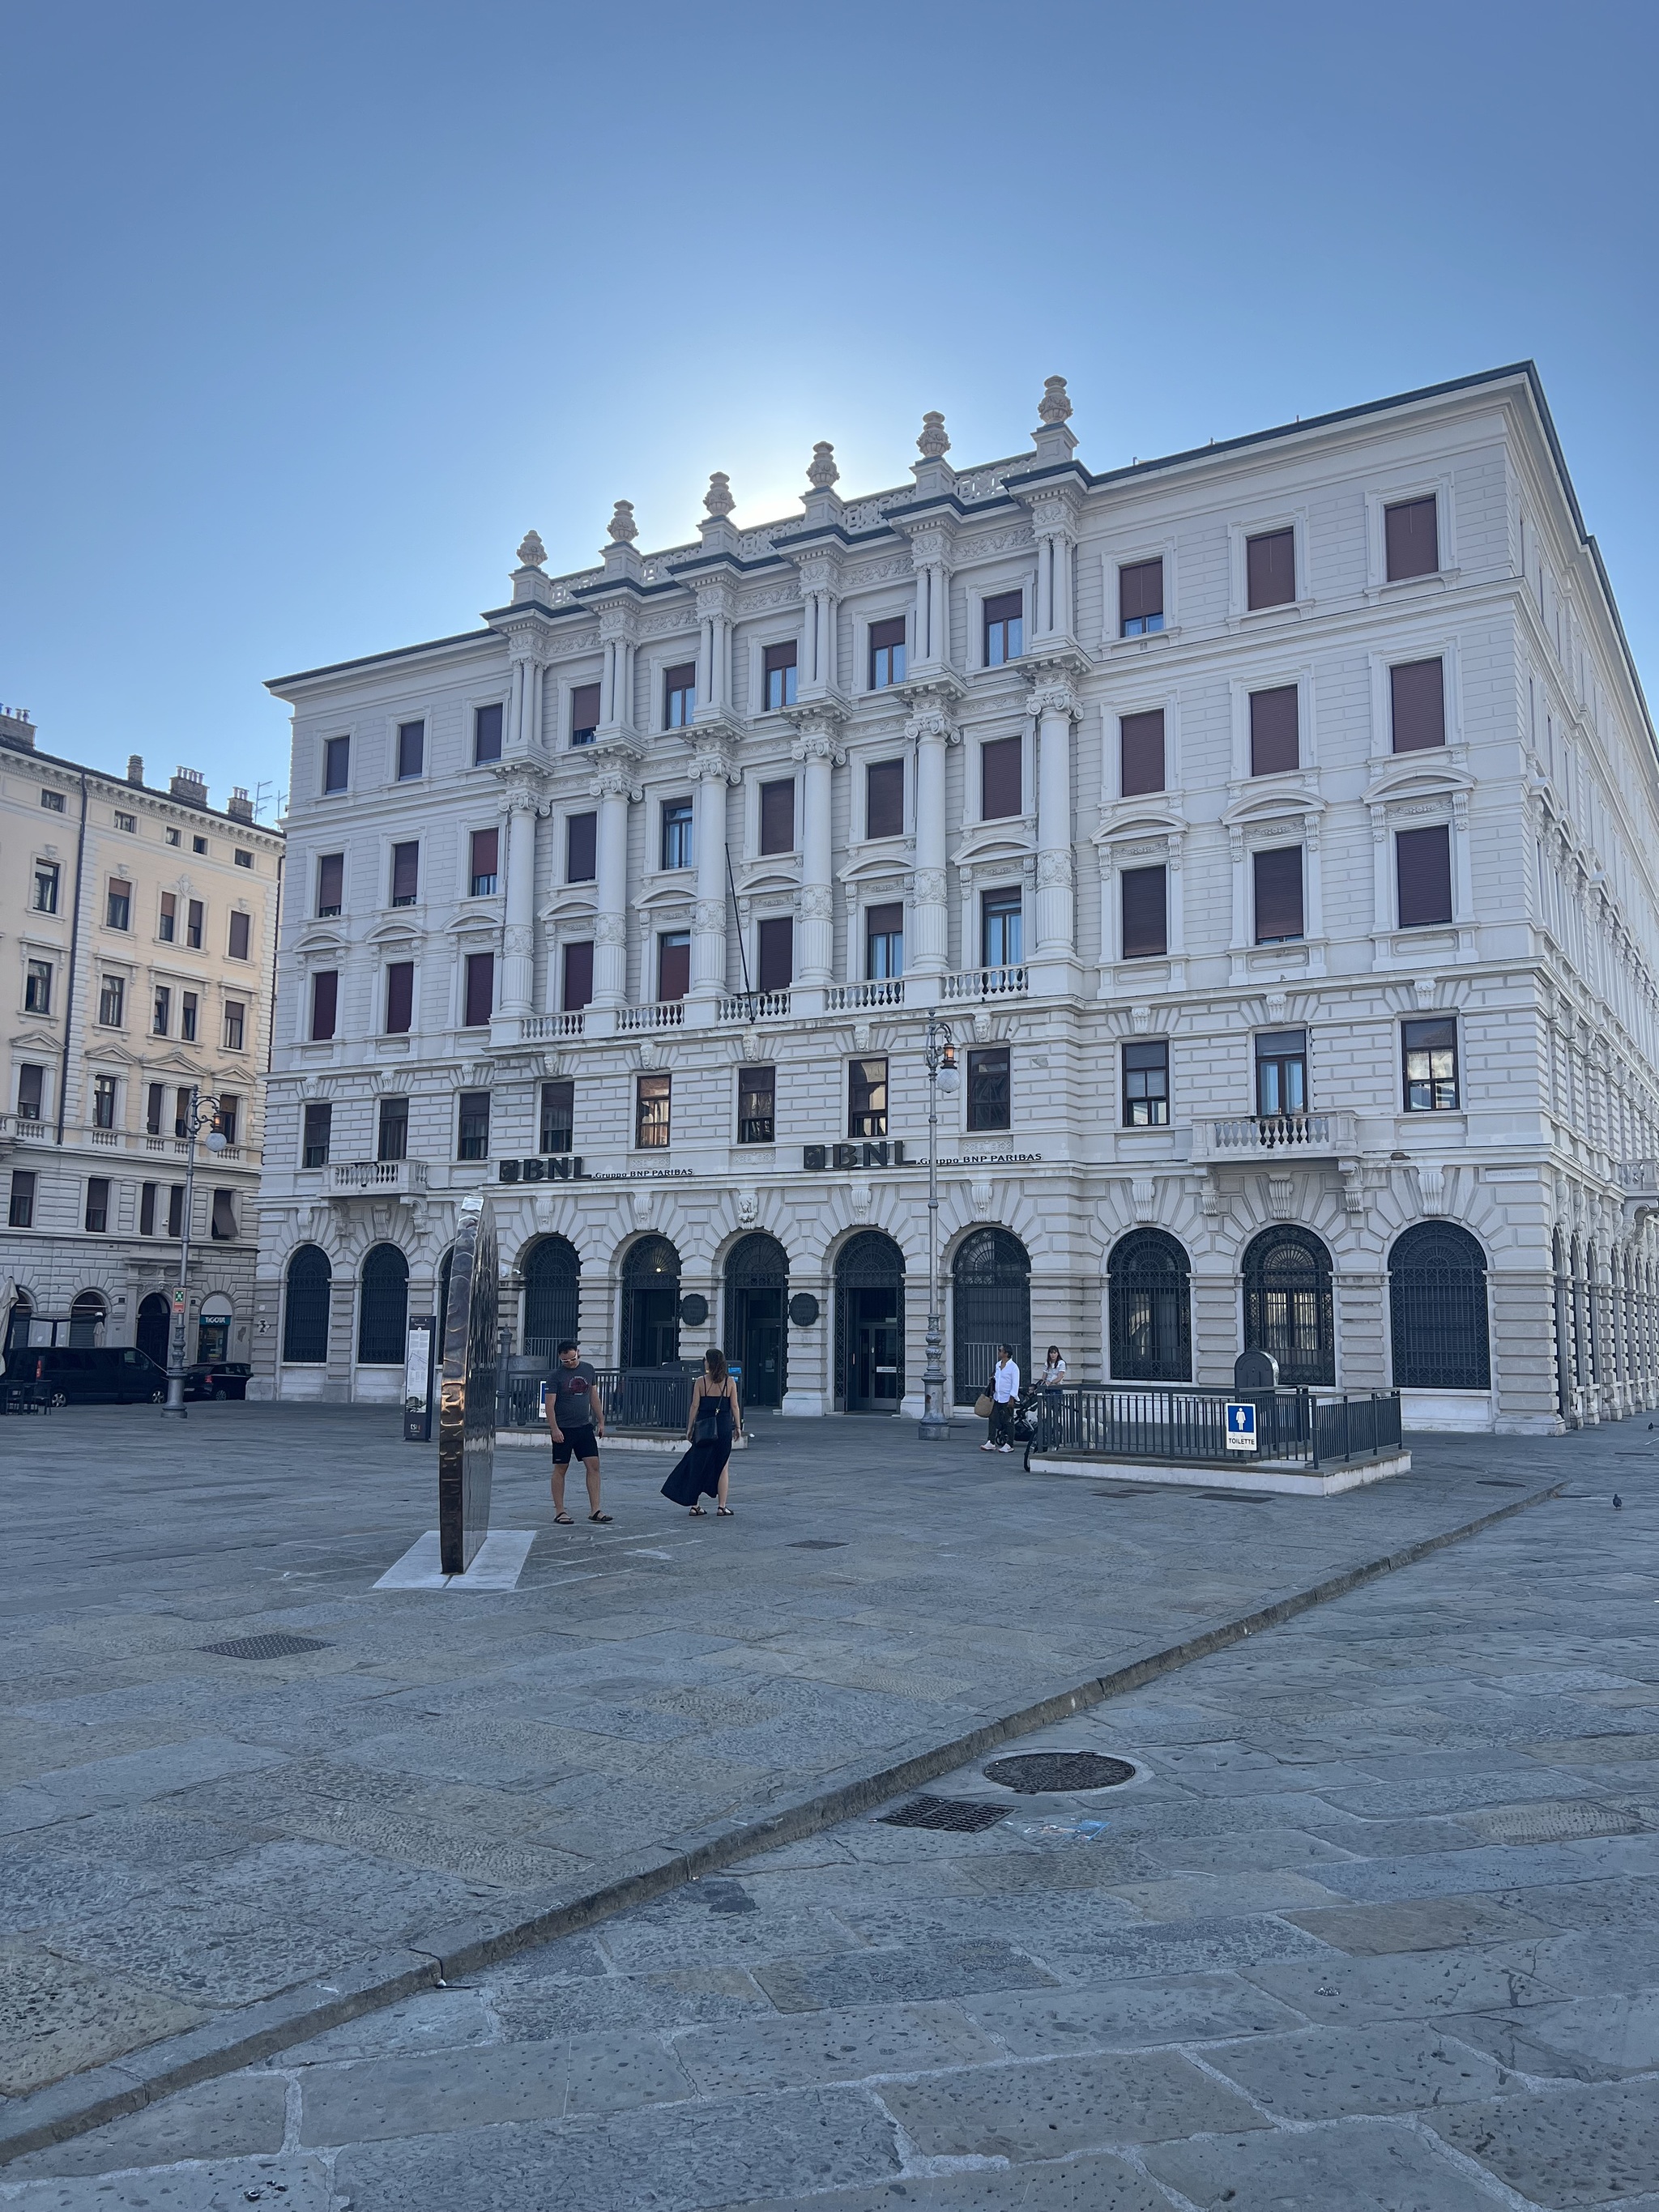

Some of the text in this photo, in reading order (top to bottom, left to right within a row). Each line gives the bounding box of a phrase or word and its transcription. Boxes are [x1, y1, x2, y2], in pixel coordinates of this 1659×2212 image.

[833, 1140, 917, 1168] BNL
[963, 1155, 987, 1163] BNP
[991, 1153, 1042, 1161] PARIBAS
[522, 1157, 592, 1181] BNL
[652, 1168, 693, 1176] PARIBAS
